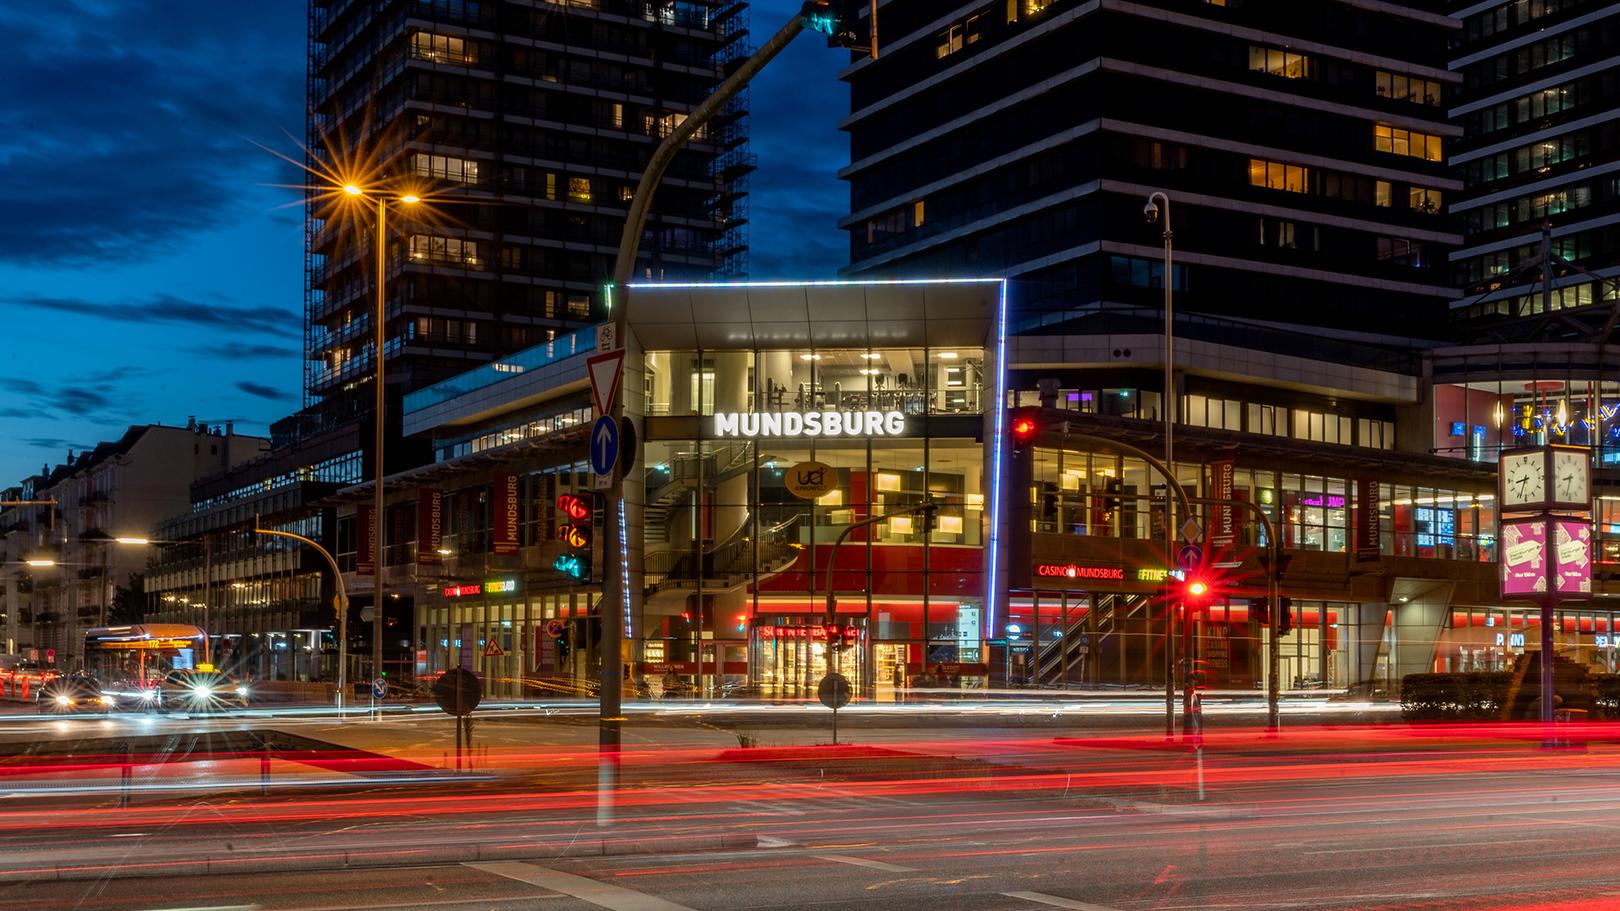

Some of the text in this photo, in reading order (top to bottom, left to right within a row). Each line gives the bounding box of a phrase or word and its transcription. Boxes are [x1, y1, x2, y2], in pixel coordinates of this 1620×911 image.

[714, 411, 906, 437] MUNDSBURG
[431, 491, 441, 553] MUNDSBURG
[507, 475, 518, 541] MUNDSBURG
[1369, 480, 1379, 547] MUNDSBURG
[1038, 565, 1124, 580] CASINO MUNDSBURG
[148, 640, 160, 649] 172
